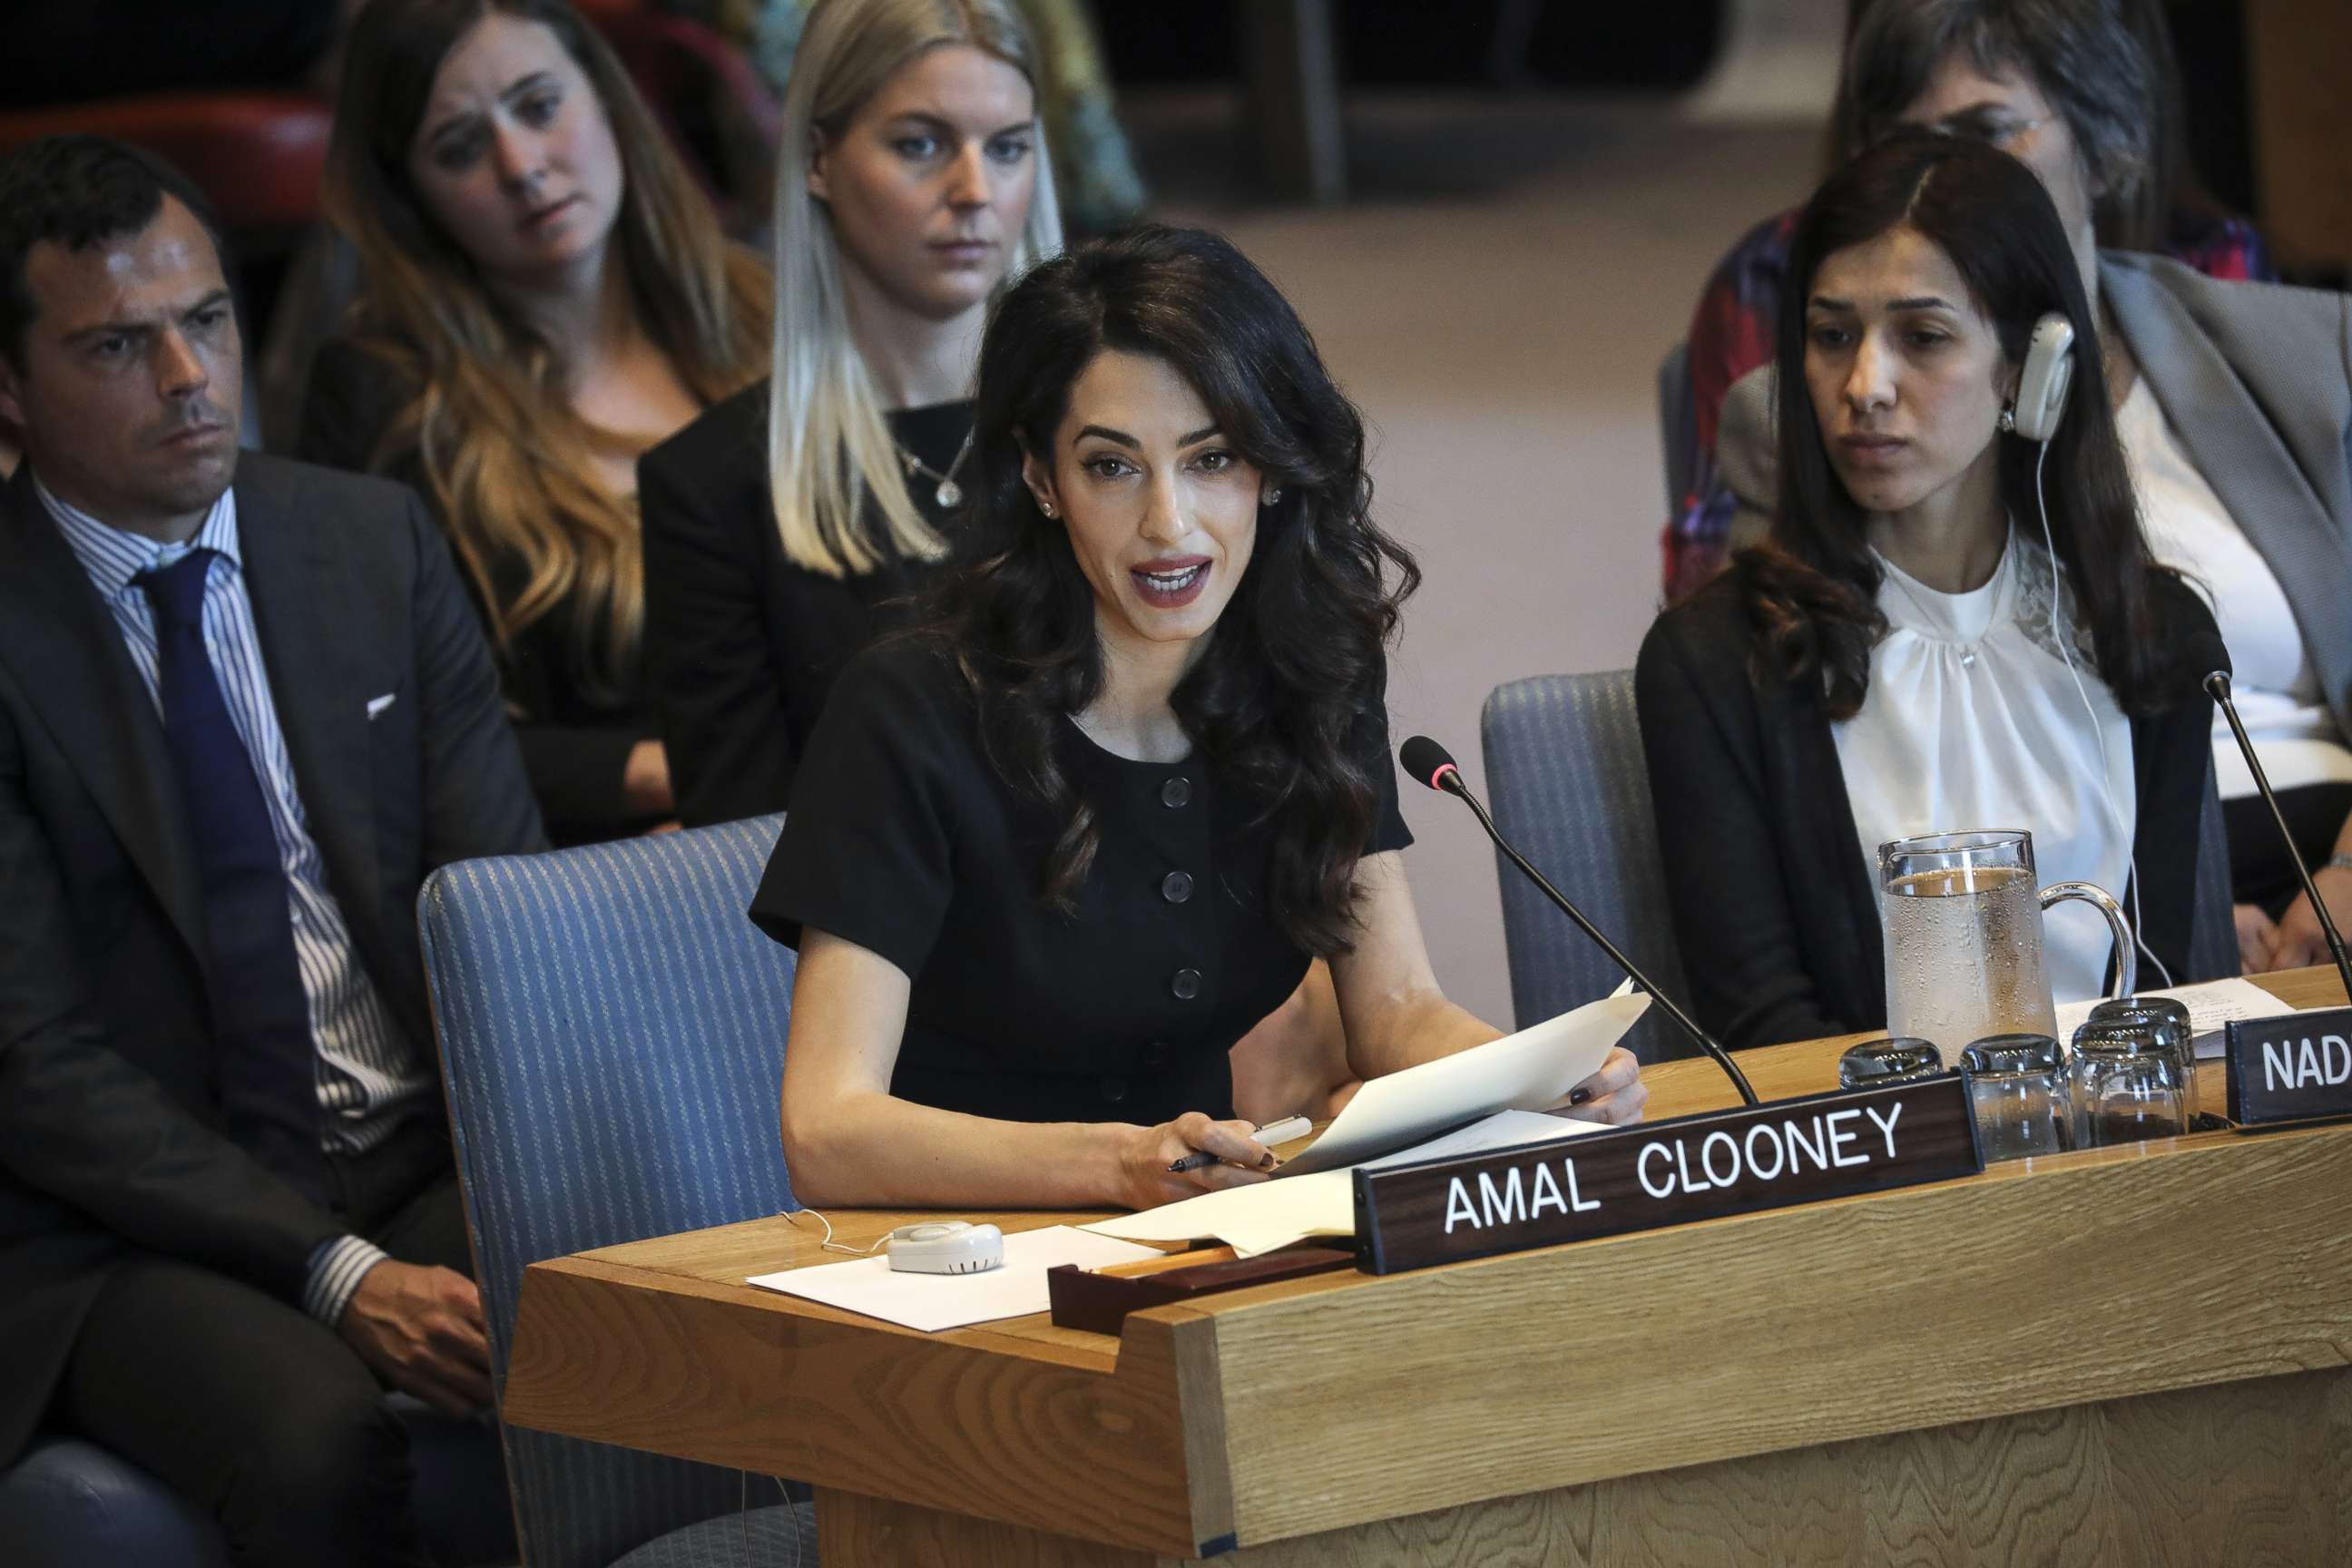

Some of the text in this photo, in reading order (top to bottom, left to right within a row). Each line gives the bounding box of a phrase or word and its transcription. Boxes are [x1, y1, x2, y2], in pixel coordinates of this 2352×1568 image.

[2262, 1034, 2352, 1092] NAD
[1445, 1102, 1903, 1234] AMAL CLOONEY
